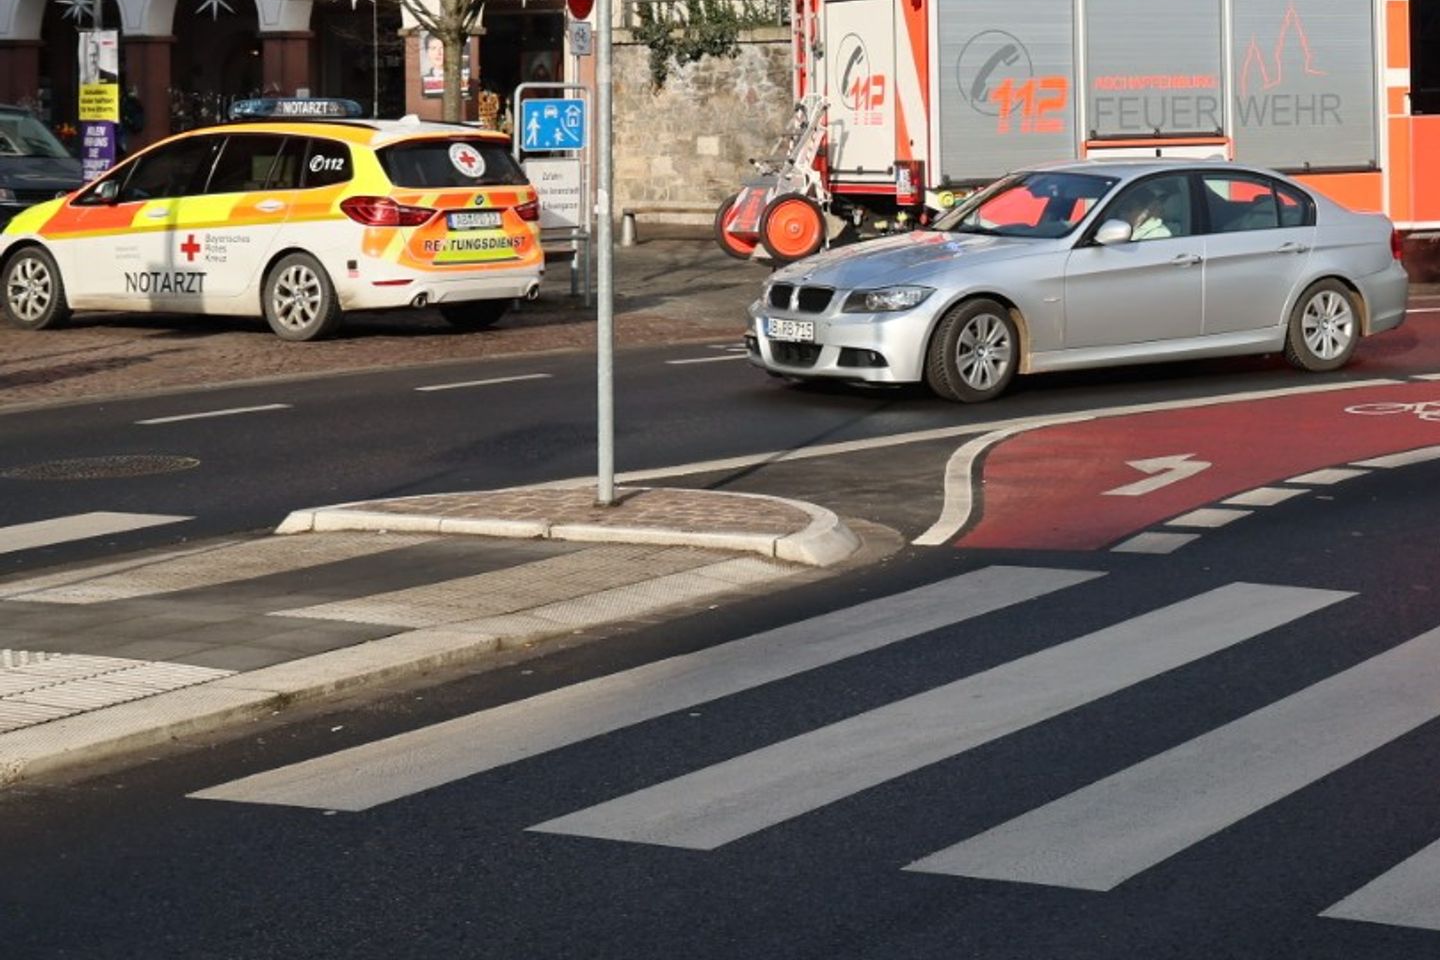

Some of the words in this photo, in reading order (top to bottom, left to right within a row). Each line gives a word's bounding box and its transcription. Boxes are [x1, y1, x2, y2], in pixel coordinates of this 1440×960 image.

[283, 101, 328, 114] NOTARZT
[850, 74, 886, 125] 112
[989, 75, 1069, 133] 112
[1094, 95, 1219, 131] FEUER
[1234, 93, 1343, 128] WEHR
[324, 158, 344, 171] 112
[125, 272, 207, 293] NOTARZT
